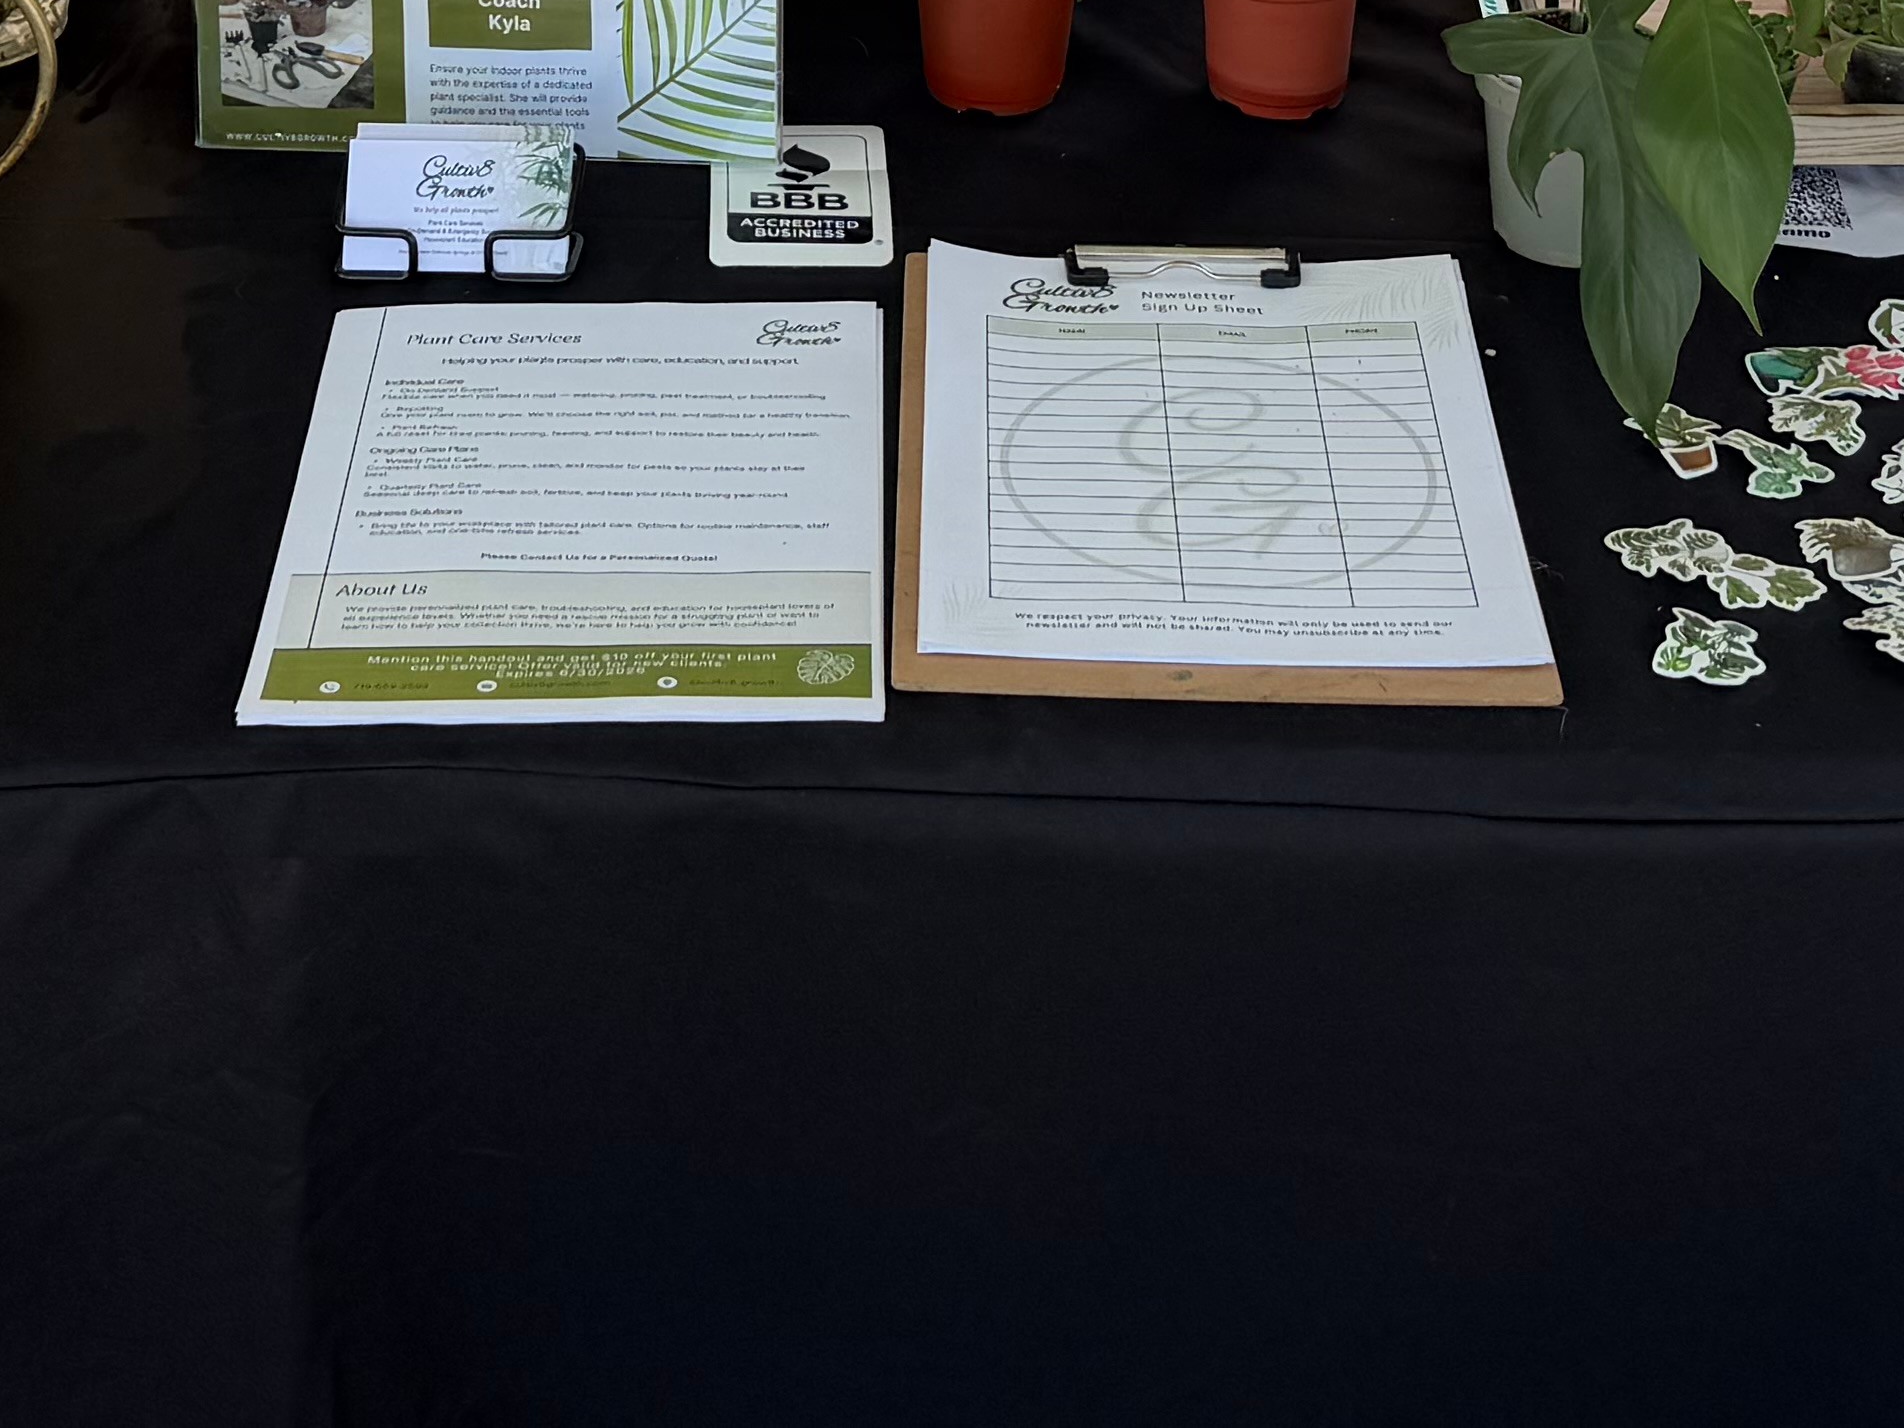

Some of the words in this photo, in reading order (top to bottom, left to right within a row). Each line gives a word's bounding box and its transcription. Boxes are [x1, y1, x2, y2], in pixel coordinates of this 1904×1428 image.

[488, 14, 532, 34] Kyla
[429, 64, 463, 74] Ensure
[465, 66, 489, 76] your
[491, 65, 522, 75] indoor
[525, 66, 556, 77] plants
[558, 67, 588, 76] thrive
[429, 78, 452, 88] with
[453, 78, 470, 88] the
[472, 80, 519, 90] expertise
[521, 80, 532, 90] of
[542, 80, 593, 90] dedicated
[429, 93, 455, 103] plant
[509, 94, 529, 103] She
[531, 94, 547, 103] will
[549, 95, 588, 105] provide
[429, 105, 476, 116] guidance
[478, 106, 497, 116] and
[499, 106, 516, 115] the
[517, 107, 563, 117] essential
[565, 107, 590, 117] tools
[422, 155, 496, 178] Cultiv8
[416, 175, 488, 201] Growth
[750, 191, 849, 210] BBB
[740, 217, 859, 230] ACCREDITED
[754, 228, 846, 239] BUSINESS
[1141, 290, 1236, 302] Newsletter
[1002, 293, 1110, 314] Growth
[1141, 302, 1178, 313] Sign
[1184, 303, 1208, 313] Up
[1213, 304, 1264, 316] Sheet
[406, 333, 454, 345] Plant
[458, 333, 503, 345] Care
[507, 332, 583, 345] Services
[335, 583, 396, 597] About
[401, 583, 428, 595] Us
[367, 654, 431, 665] Mention
[435, 654, 463, 663] this
[468, 654, 531, 664] handout
[536, 653, 564, 662] and
[570, 653, 596, 665] get
[634, 652, 655, 660] off
[660, 652, 695, 663] your
[701, 652, 731, 661] first
[737, 652, 777, 662] plant
[410, 663, 444, 672] care
[517, 661, 559, 671] Offer
[633, 660, 664, 668] new
